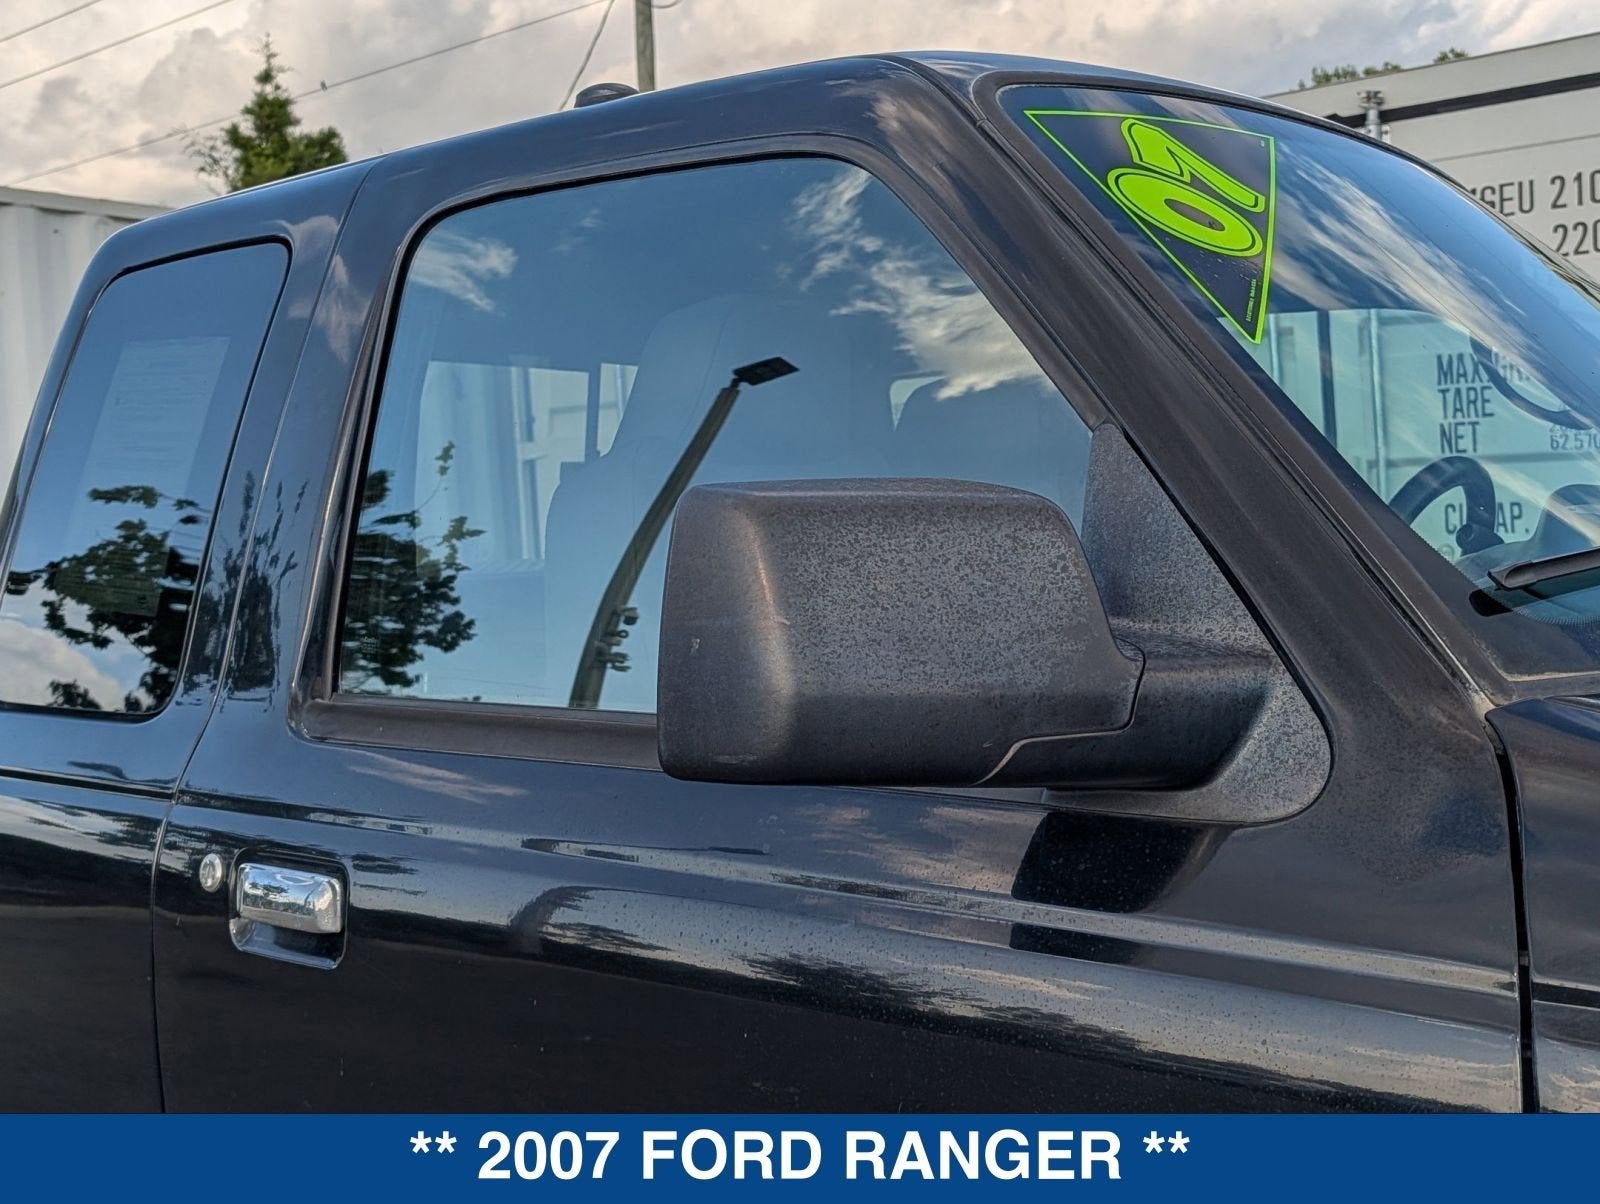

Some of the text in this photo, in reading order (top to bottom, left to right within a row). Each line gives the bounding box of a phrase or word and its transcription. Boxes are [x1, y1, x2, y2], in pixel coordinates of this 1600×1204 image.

[1470, 179, 1534, 217] GEU
[1437, 386, 1495, 419] TARE
[1439, 421, 1481, 454] NET
